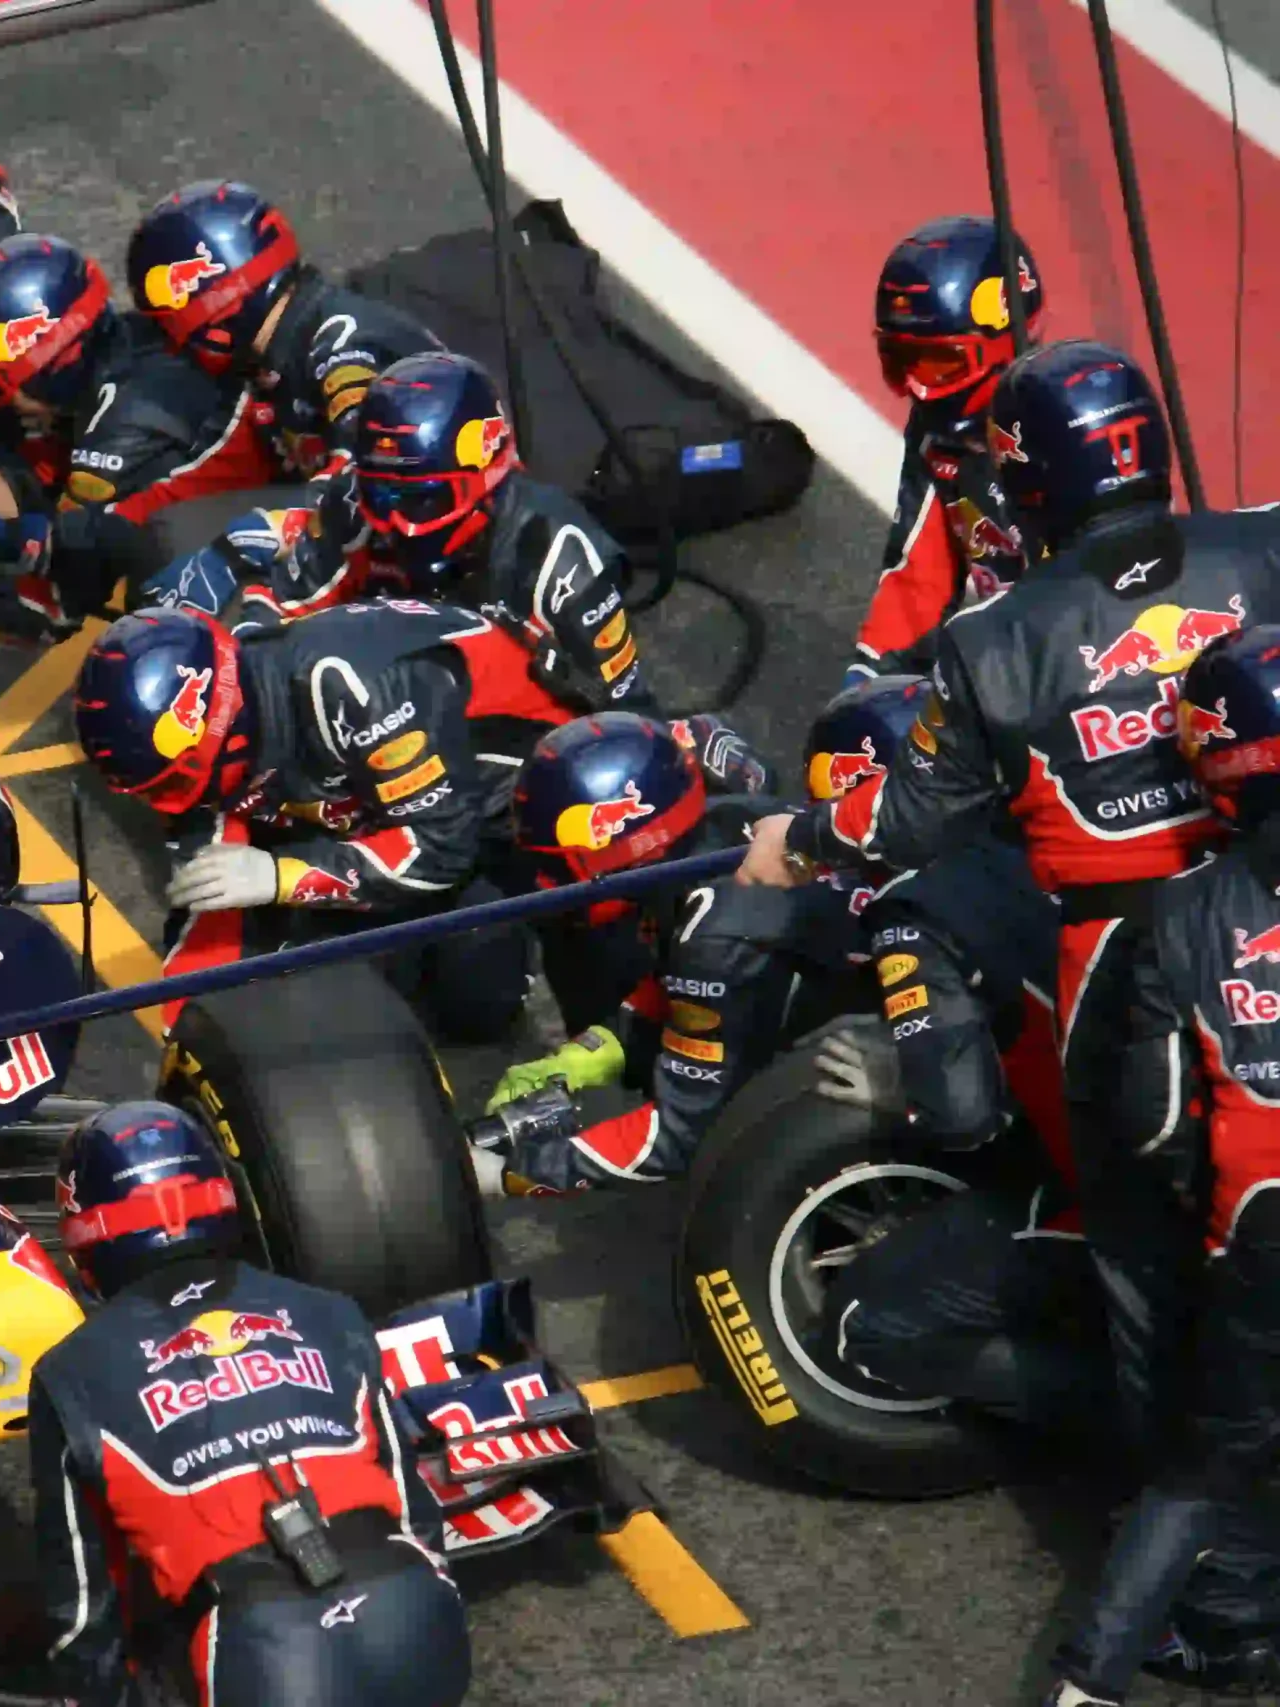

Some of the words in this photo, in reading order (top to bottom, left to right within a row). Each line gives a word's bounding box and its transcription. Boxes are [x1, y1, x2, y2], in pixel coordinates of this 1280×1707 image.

[70, 448, 124, 471] CASIO
[353, 701, 416, 747] CASIO
[1070, 676, 1182, 763] Red
[387, 780, 453, 816] GEOX
[1097, 787, 1169, 820] GIVES
[1220, 979, 1280, 1026] Re
[1234, 1060, 1280, 1082] GIVE
[695, 1269, 799, 1426] PIRELLI
[138, 1357, 247, 1433] Red
[236, 1347, 334, 1394] Bull
[235, 1422, 284, 1449] YOU
